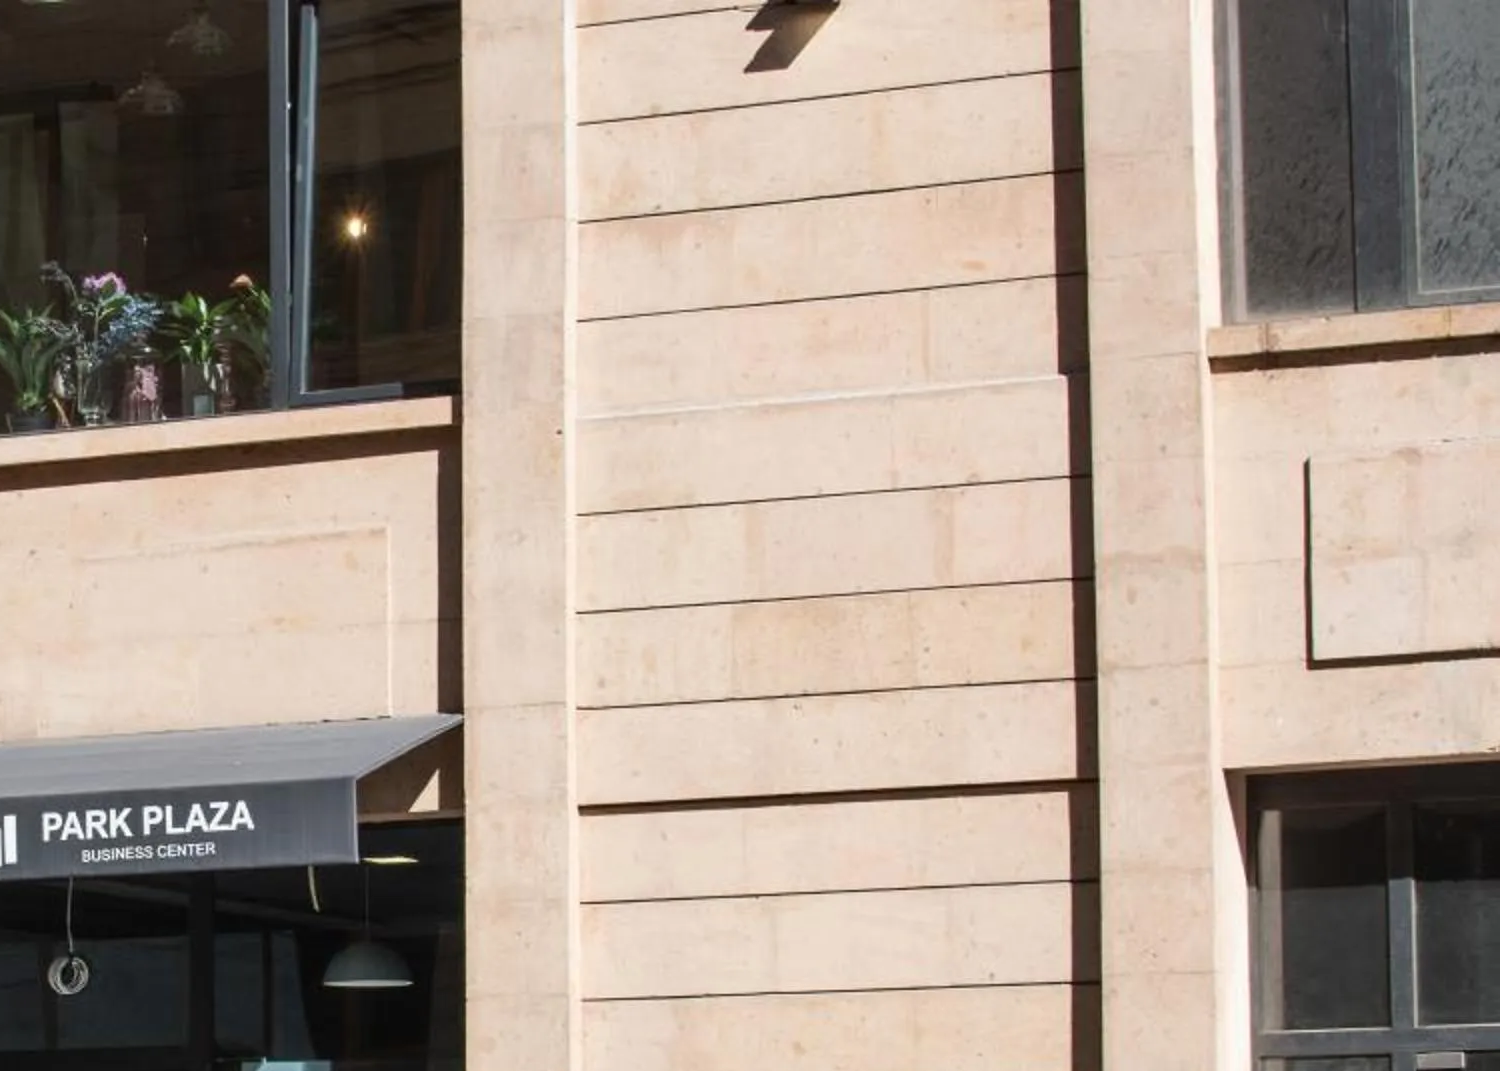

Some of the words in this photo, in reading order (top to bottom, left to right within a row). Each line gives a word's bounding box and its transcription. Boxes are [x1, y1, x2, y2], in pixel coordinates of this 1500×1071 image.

[41, 806, 133, 842] PARK
[142, 799, 255, 836] PLAZA
[81, 845, 154, 863] BUSINESS
[157, 841, 216, 859] CENTER
